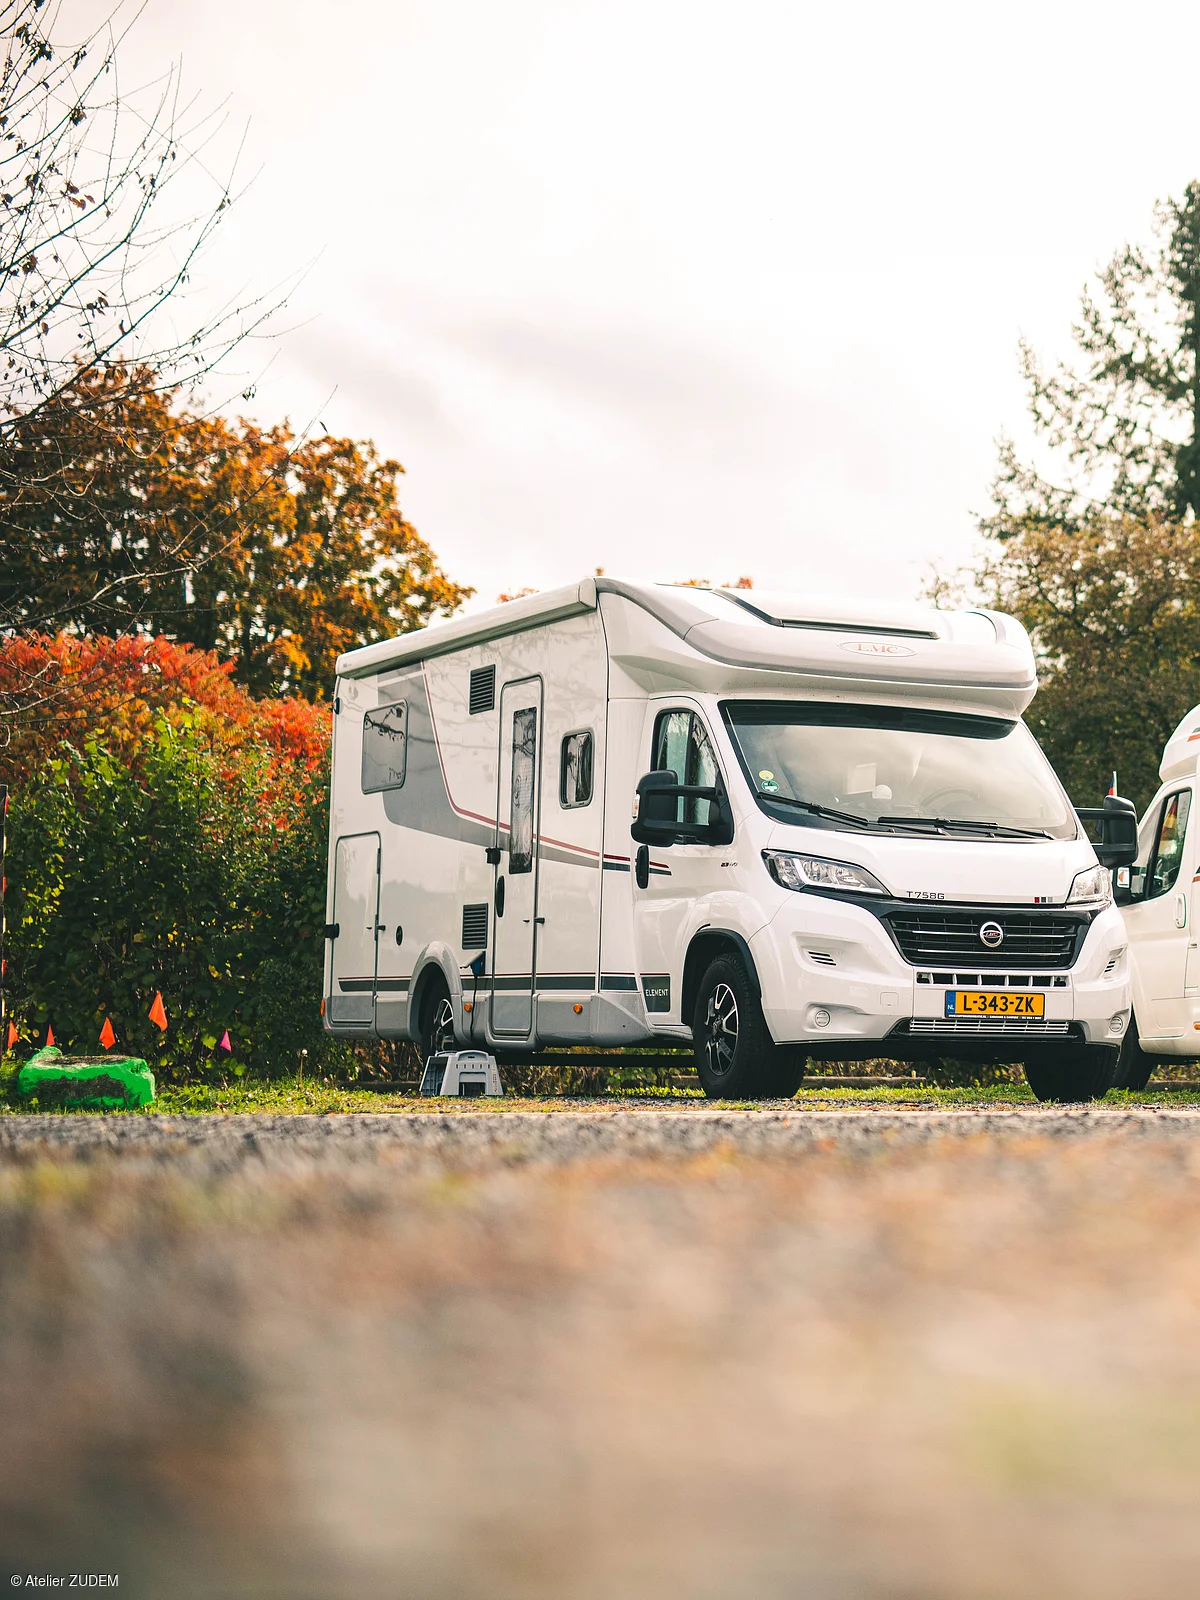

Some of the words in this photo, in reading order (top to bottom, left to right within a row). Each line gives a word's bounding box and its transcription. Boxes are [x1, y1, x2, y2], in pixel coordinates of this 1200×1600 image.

[906, 890, 945, 900] T758G
[645, 988, 669, 997] ELEMENT
[963, 994, 1035, 1013] L-343-ZK
